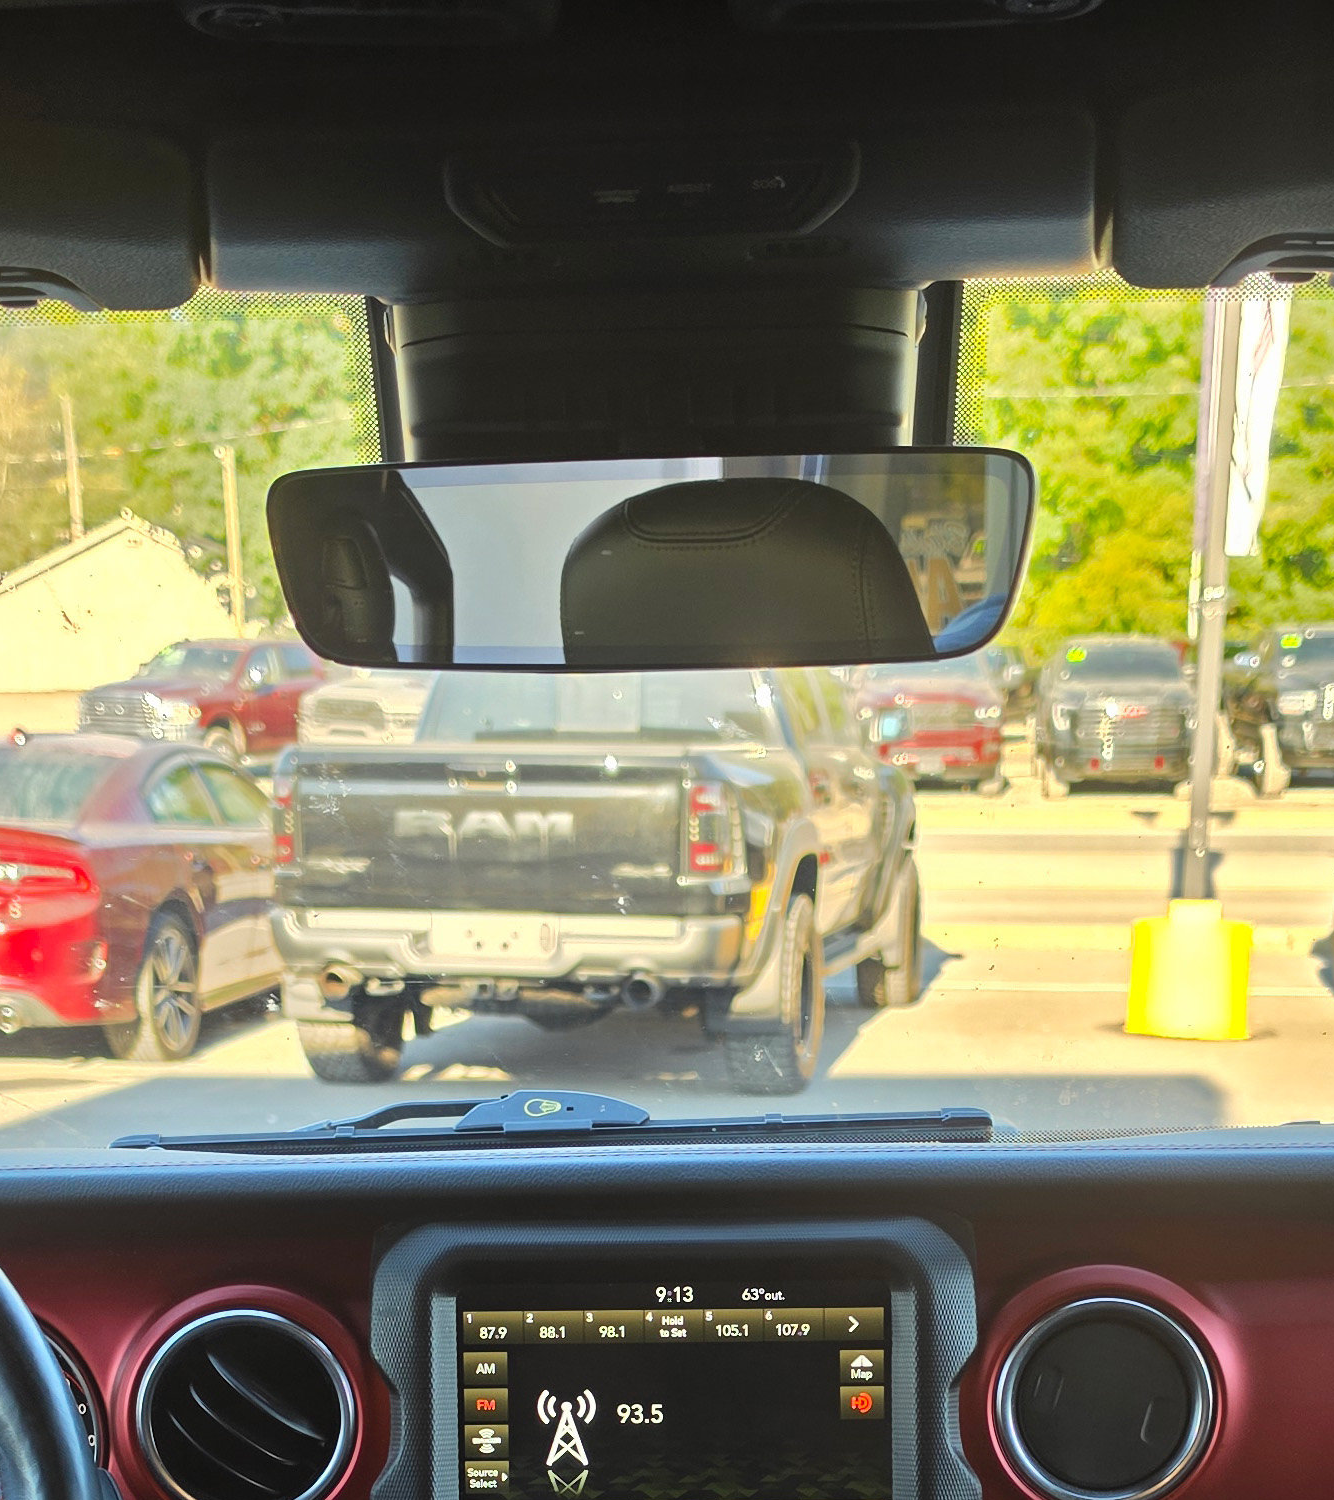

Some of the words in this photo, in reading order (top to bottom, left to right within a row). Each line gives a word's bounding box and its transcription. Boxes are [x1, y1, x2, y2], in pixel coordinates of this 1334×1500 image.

[394, 810, 574, 838] RAM
[655, 1286, 694, 1303] 9:13
[466, 1314, 472, 1324] 1
[526, 1313, 534, 1323] 2
[586, 1313, 593, 1322] 3
[645, 1312, 653, 1322] 4
[662, 1315, 684, 1326] Hold
[705, 1311, 713, 1321] 5
[765, 1311, 773, 1320] 6
[479, 1326, 507, 1339] 87.9
[539, 1326, 566, 1339] 88.1
[598, 1325, 626, 1338] 98.1
[659, 1328, 670, 1337] to
[671, 1328, 687, 1338] Set
[716, 1324, 749, 1337] 105.1
[775, 1323, 811, 1337] 107.9
[476, 1363, 496, 1375] AM
[850, 1368, 873, 1380] Map
[476, 1399, 496, 1411] FM
[616, 1403, 664, 1424] 93.5
[467, 1468, 498, 1478] Source
[469, 1479, 498, 1488] Select
